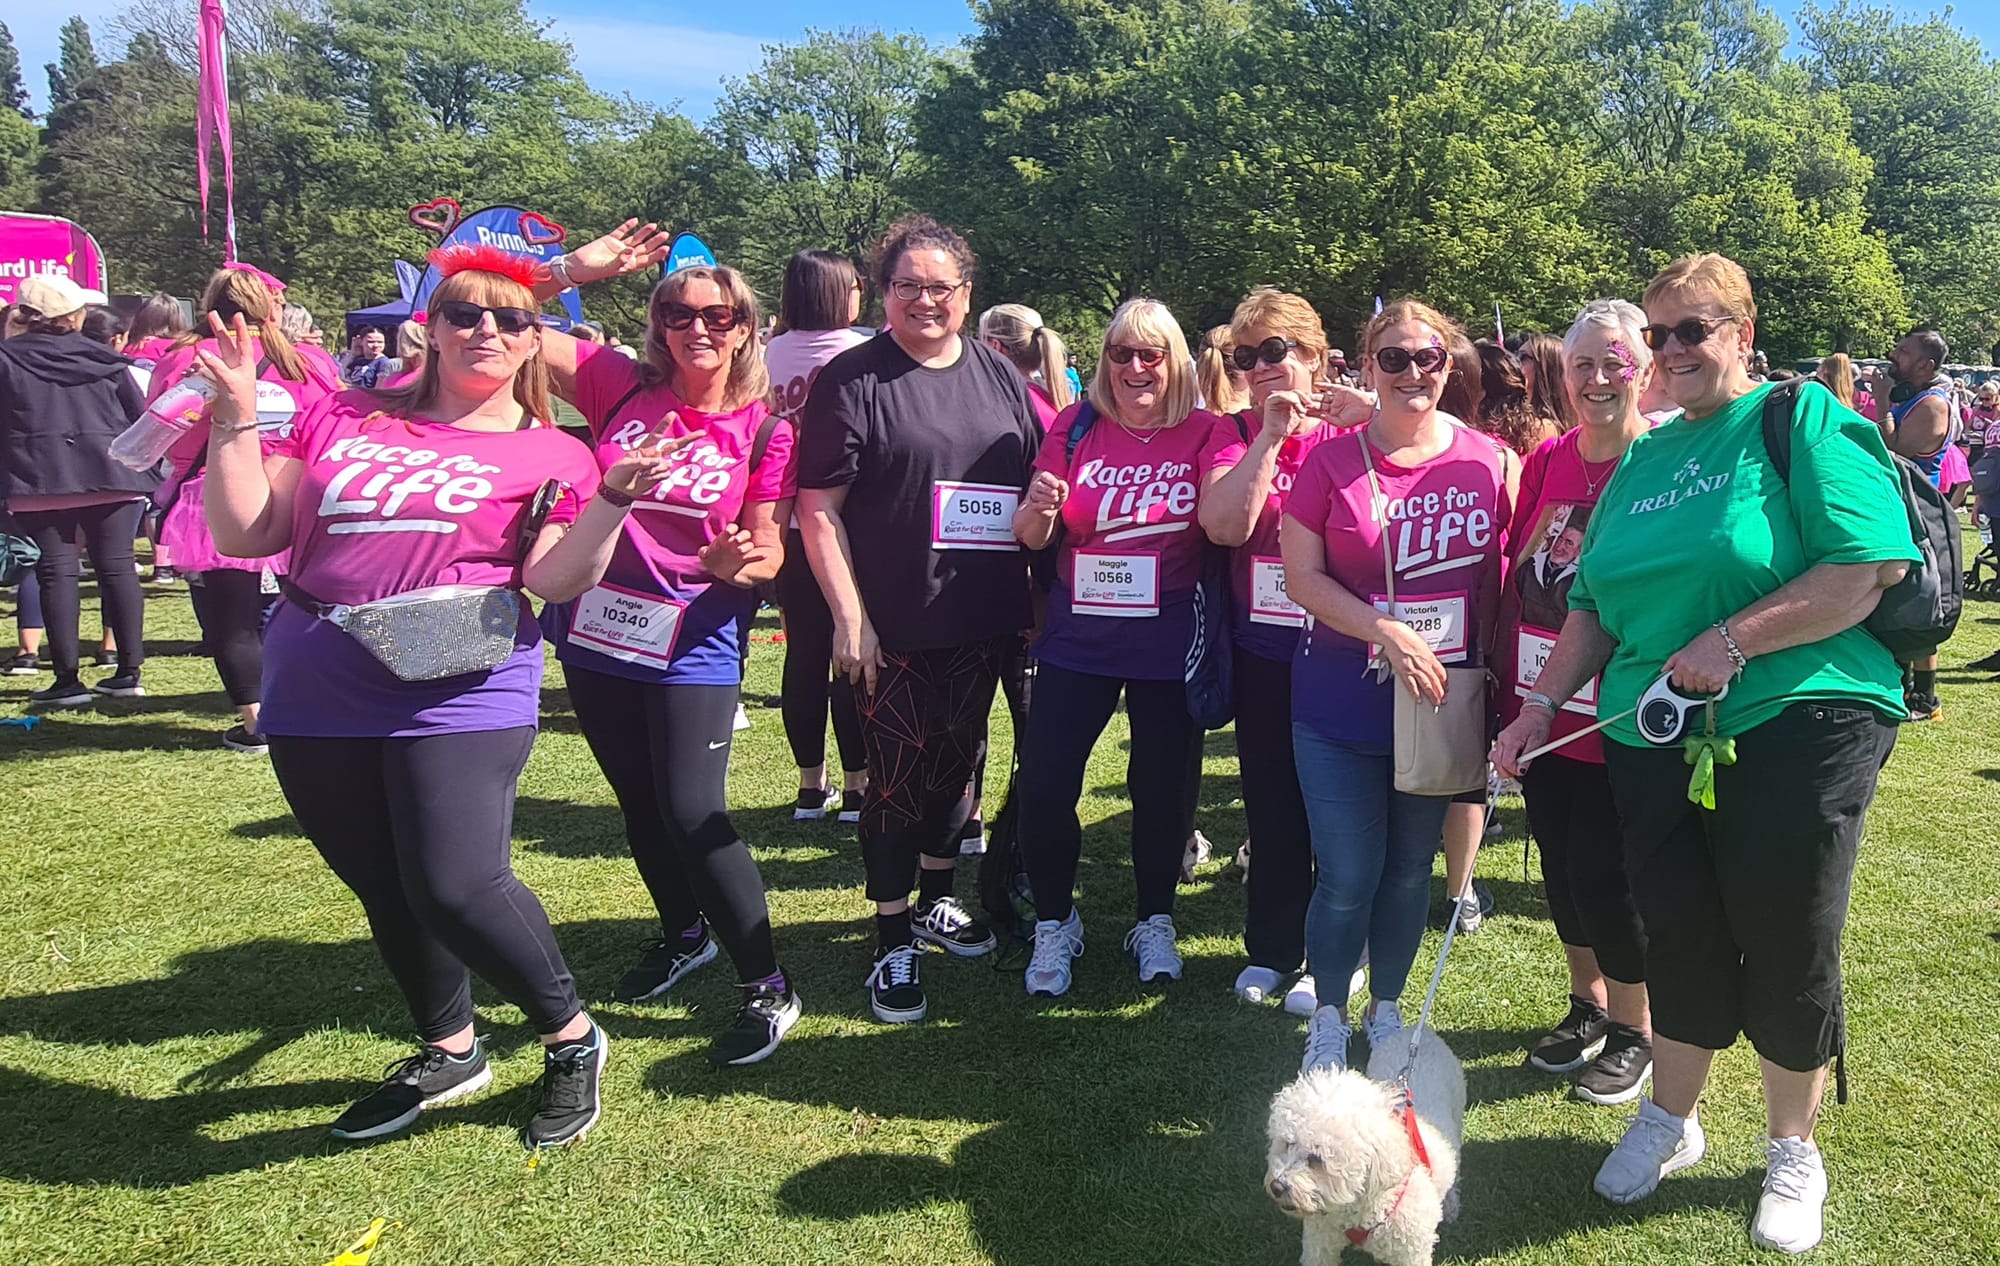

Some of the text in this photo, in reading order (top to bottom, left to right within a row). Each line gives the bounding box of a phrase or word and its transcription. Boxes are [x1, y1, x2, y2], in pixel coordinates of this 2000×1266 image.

[319, 435, 502, 475] Race for
[691, 445, 738, 469] for
[1077, 459, 1192, 489] Race for
[318, 461, 493, 517] Life
[1628, 472, 1730, 515] IRELAND
[959, 499, 1002, 516] 5058
[1095, 481, 1197, 532] Life
[1370, 486, 1479, 526] Race for
[1394, 508, 1491, 572] Life
[1098, 560, 1128, 569] Maggie
[1094, 571, 1133, 584] 10568
[616, 598, 643, 610] Angie
[1404, 605, 1439, 615] Victoria
[602, 606, 649, 629] 10340
[1402, 617, 1442, 632] 0288
